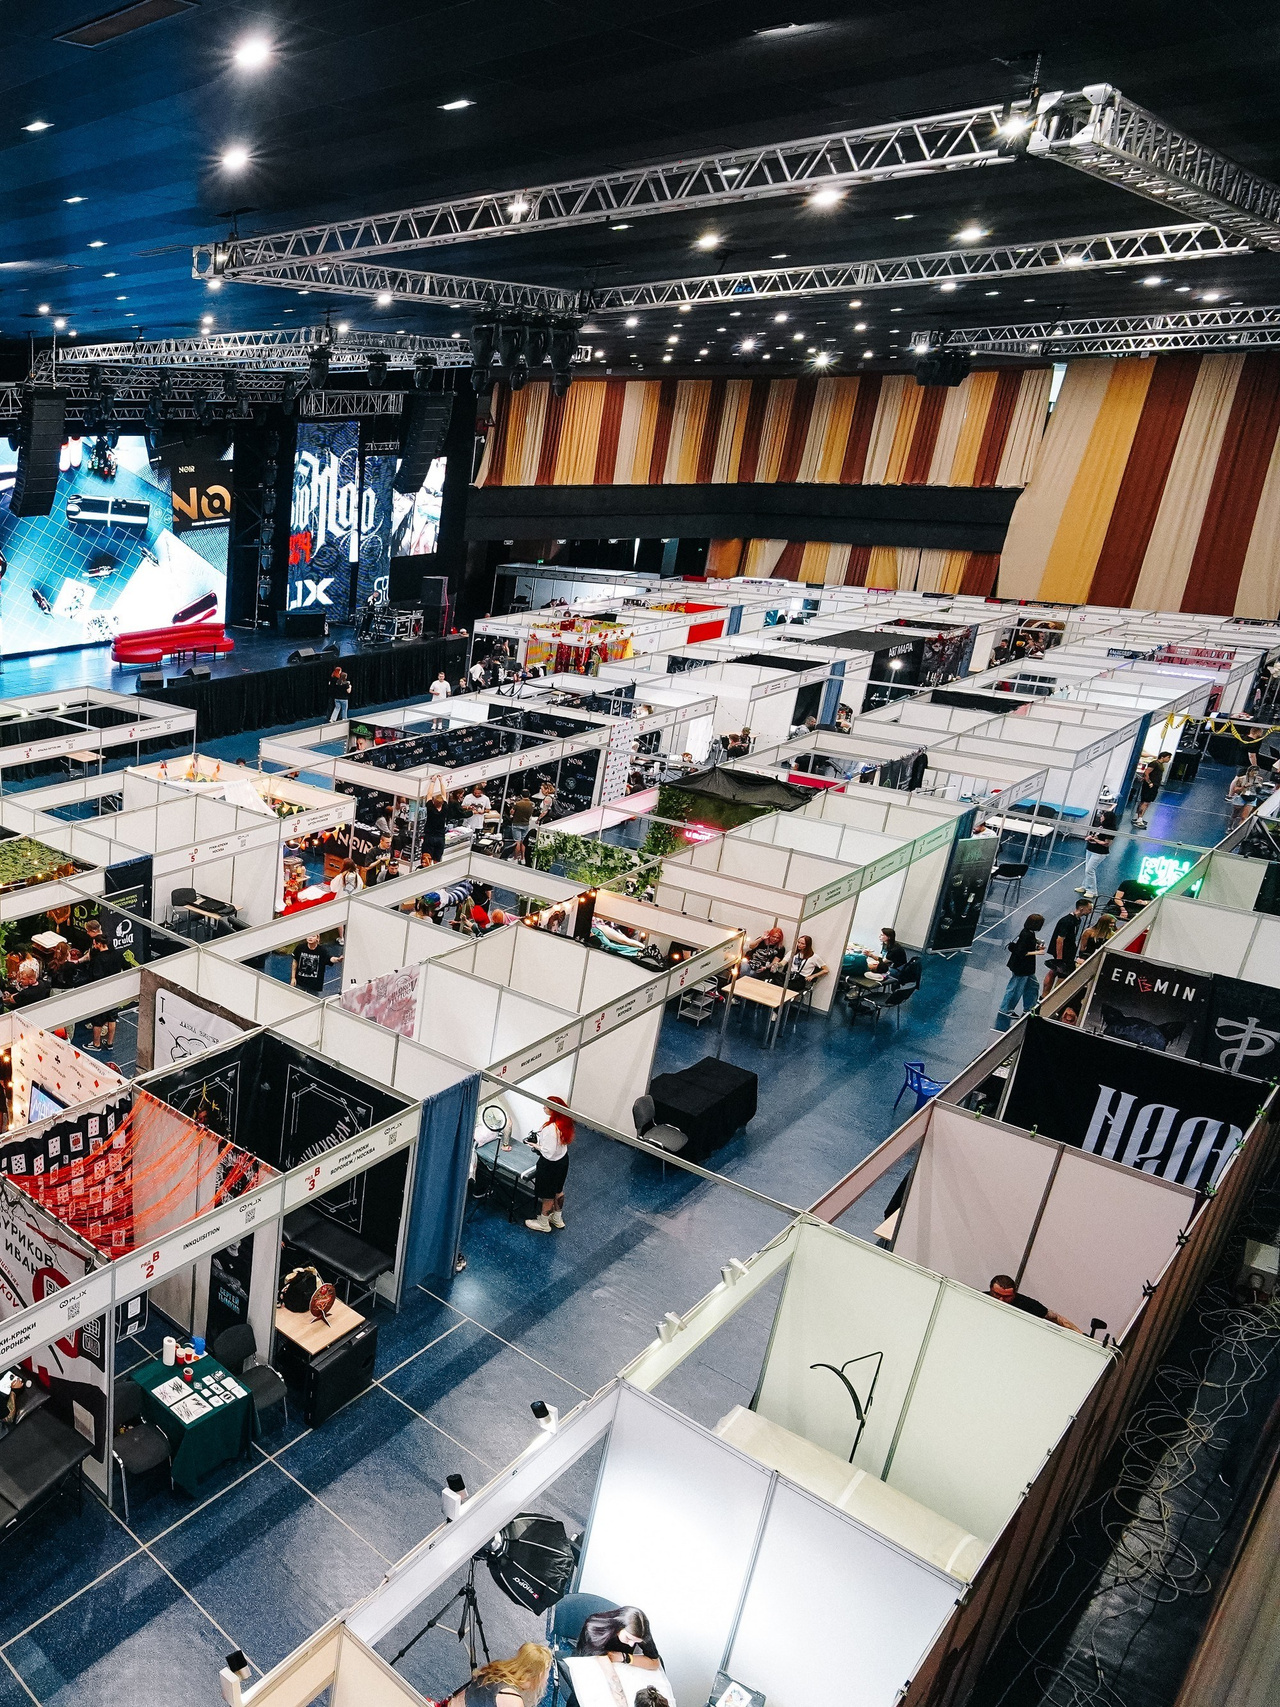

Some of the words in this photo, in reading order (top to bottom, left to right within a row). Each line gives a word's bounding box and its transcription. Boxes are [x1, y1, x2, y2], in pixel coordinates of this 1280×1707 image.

[178, 465, 196, 474] NOIR
[337, 831, 374, 855] NOIR
[596, 1021, 602, 1032] 5
[330, 1158, 354, 1176] ВОРОНЕЖ
[356, 1146, 376, 1161] МОСКВА
[338, 1143, 370, 1164] РУКИ-КРЮКИ
[308, 1178, 316, 1191] 3
[182, 1226, 221, 1251] INKQUISITION
[4, 1238, 39, 1276] ИВАН
[145, 1264, 155, 1279] 2
